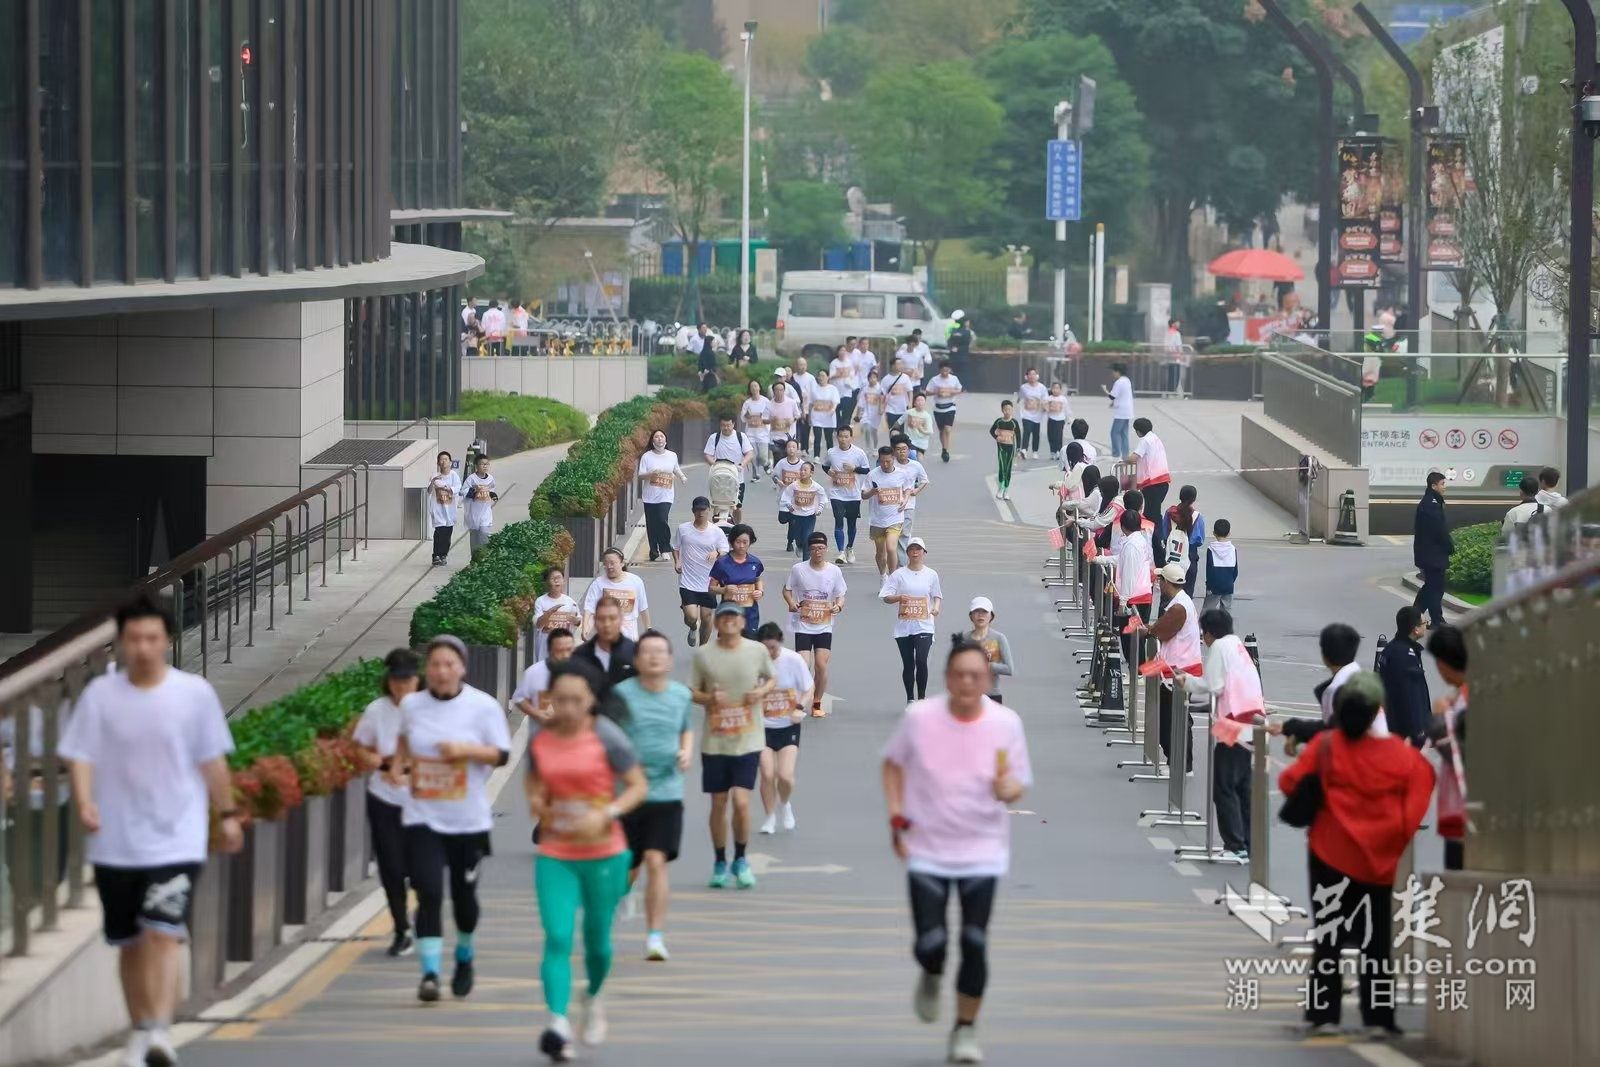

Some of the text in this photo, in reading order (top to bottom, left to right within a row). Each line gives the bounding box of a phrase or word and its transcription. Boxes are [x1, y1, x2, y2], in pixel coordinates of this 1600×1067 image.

[1478, 433, 1486, 444] 5
[1361, 440, 1408, 448] ENTRANCE
[904, 606, 923, 614] A152
